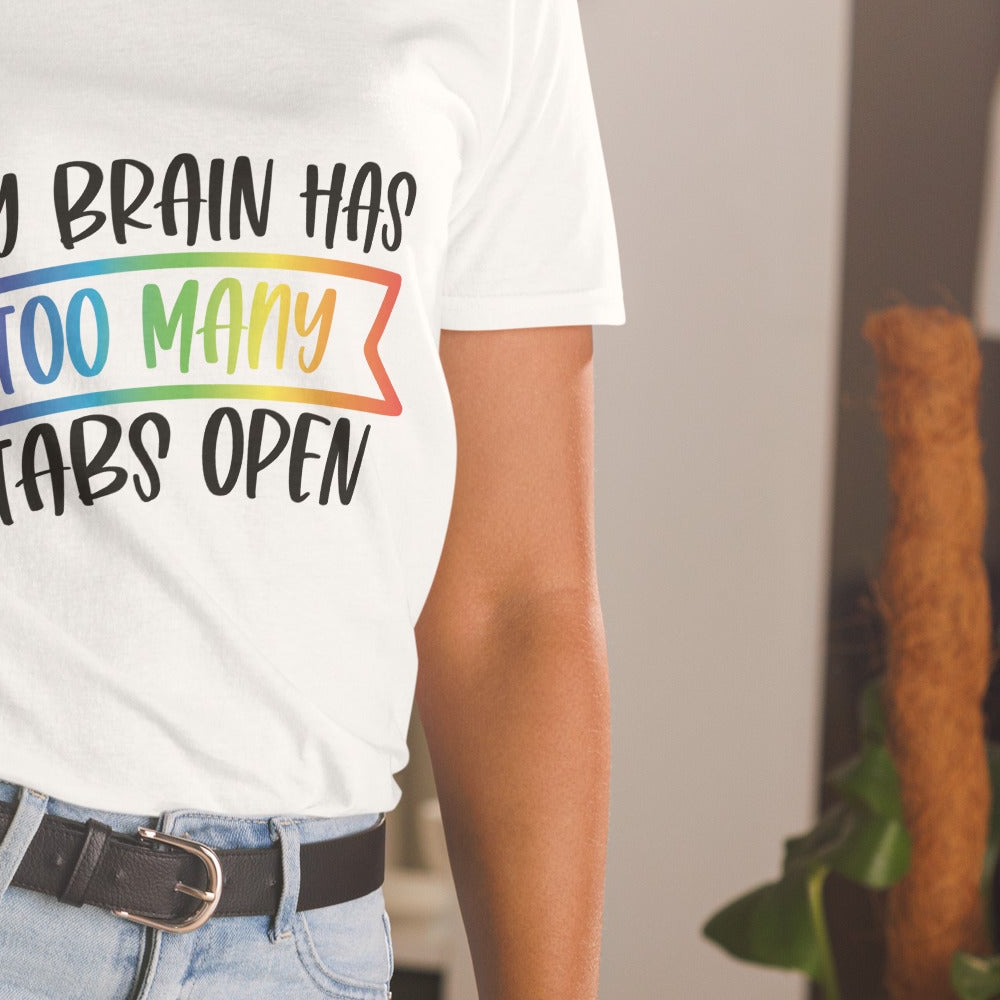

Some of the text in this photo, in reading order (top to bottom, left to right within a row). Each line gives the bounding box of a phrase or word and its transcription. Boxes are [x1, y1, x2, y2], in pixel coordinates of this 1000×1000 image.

[53, 152, 274, 250] BRAIN
[299, 161, 417, 254] HAS
[201, 406, 372, 507] OPEN
